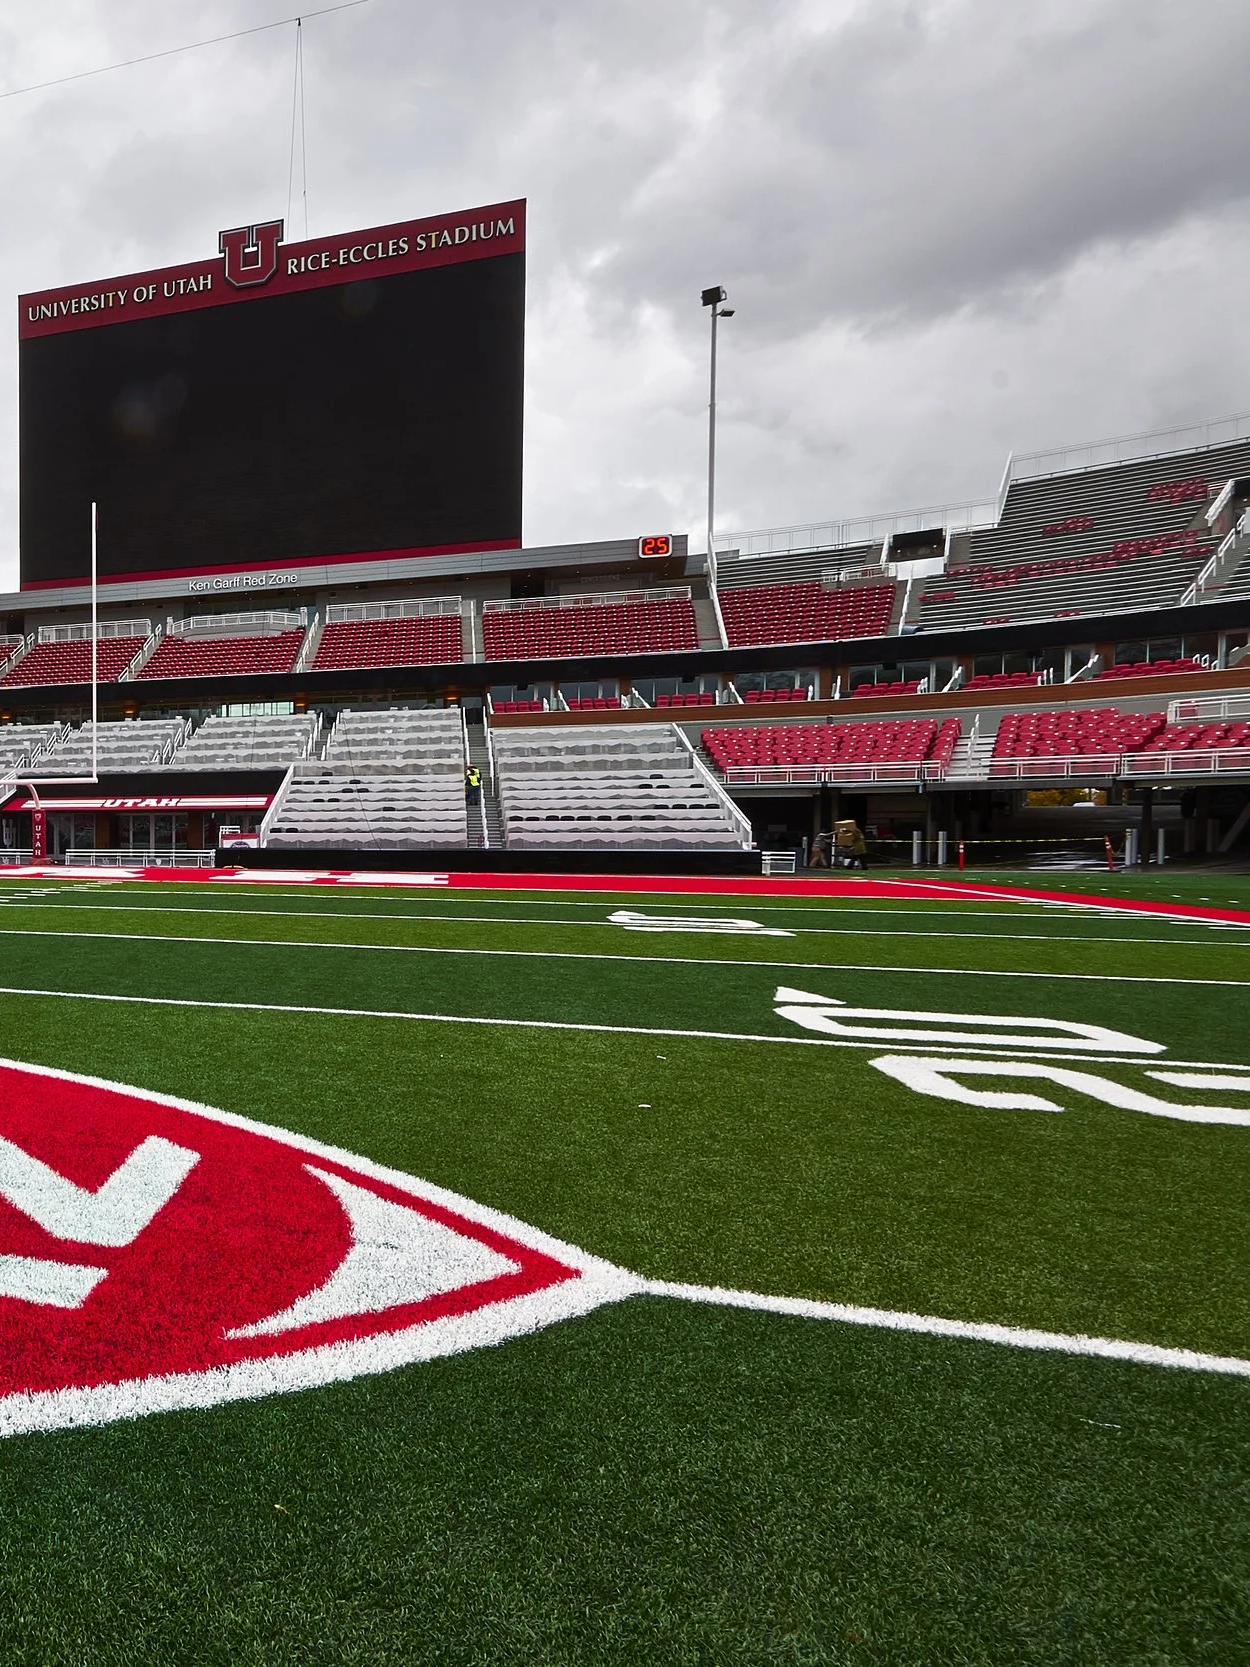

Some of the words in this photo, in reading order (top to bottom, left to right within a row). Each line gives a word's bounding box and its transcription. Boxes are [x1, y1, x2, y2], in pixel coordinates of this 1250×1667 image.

[218, 219, 284, 288] U
[287, 237, 409, 275] RICE-ECCLES
[416, 217, 515, 252] STADIUM
[28, 289, 128, 322] UNIVERSITY
[133, 284, 157, 304] OF
[163, 274, 213, 298] UTAH
[644, 536, 668, 555] 25
[188, 581, 210, 591] Ken
[213, 577, 241, 590] Garff
[243, 575, 266, 587] Red
[268, 573, 298, 585] Zone
[103, 798, 182, 807] UTAH
